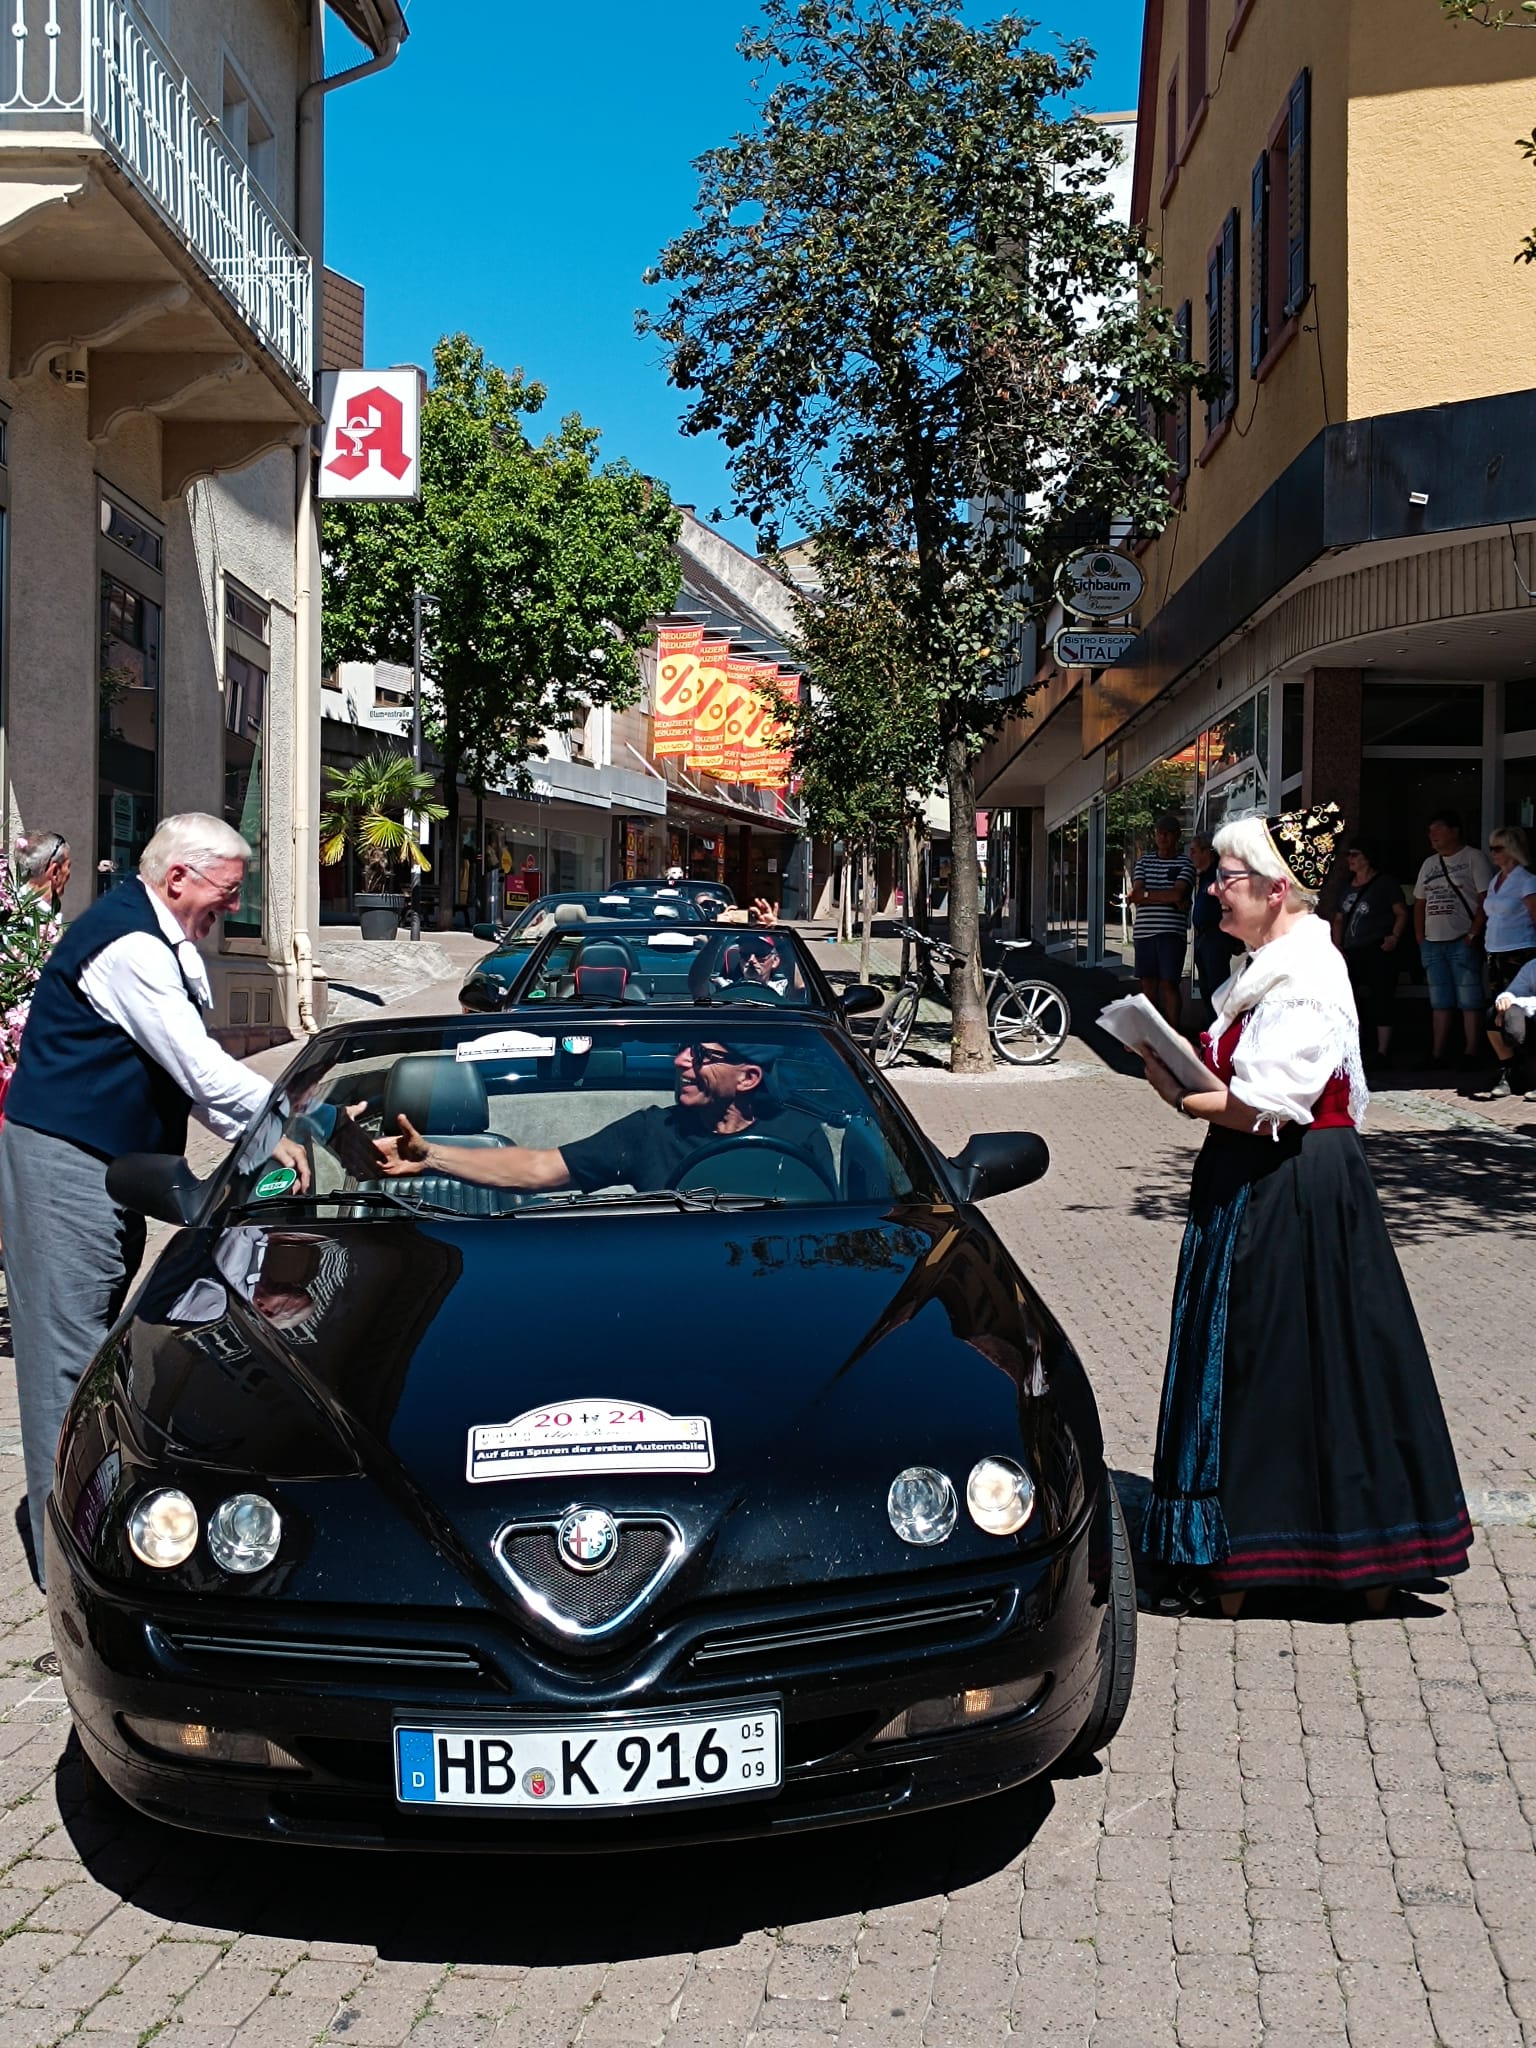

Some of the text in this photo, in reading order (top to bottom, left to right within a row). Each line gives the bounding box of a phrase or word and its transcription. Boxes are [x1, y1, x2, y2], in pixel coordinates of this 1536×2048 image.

[1073, 578, 1130, 592] Eichbaum
[661, 631, 701, 640] REDUZIERT
[1065, 636, 1097, 644] BISTRO
[370, 710, 410, 718] Blumenstraße
[534, 1409, 646, 1428] 20 24
[476, 1441, 705, 1460] Auf den Spuren der ersten Automobile
[741, 1722, 765, 1739] 05
[437, 1727, 729, 1796] HB K 916
[741, 1762, 765, 1779] 09
[411, 1771, 425, 1788] D
